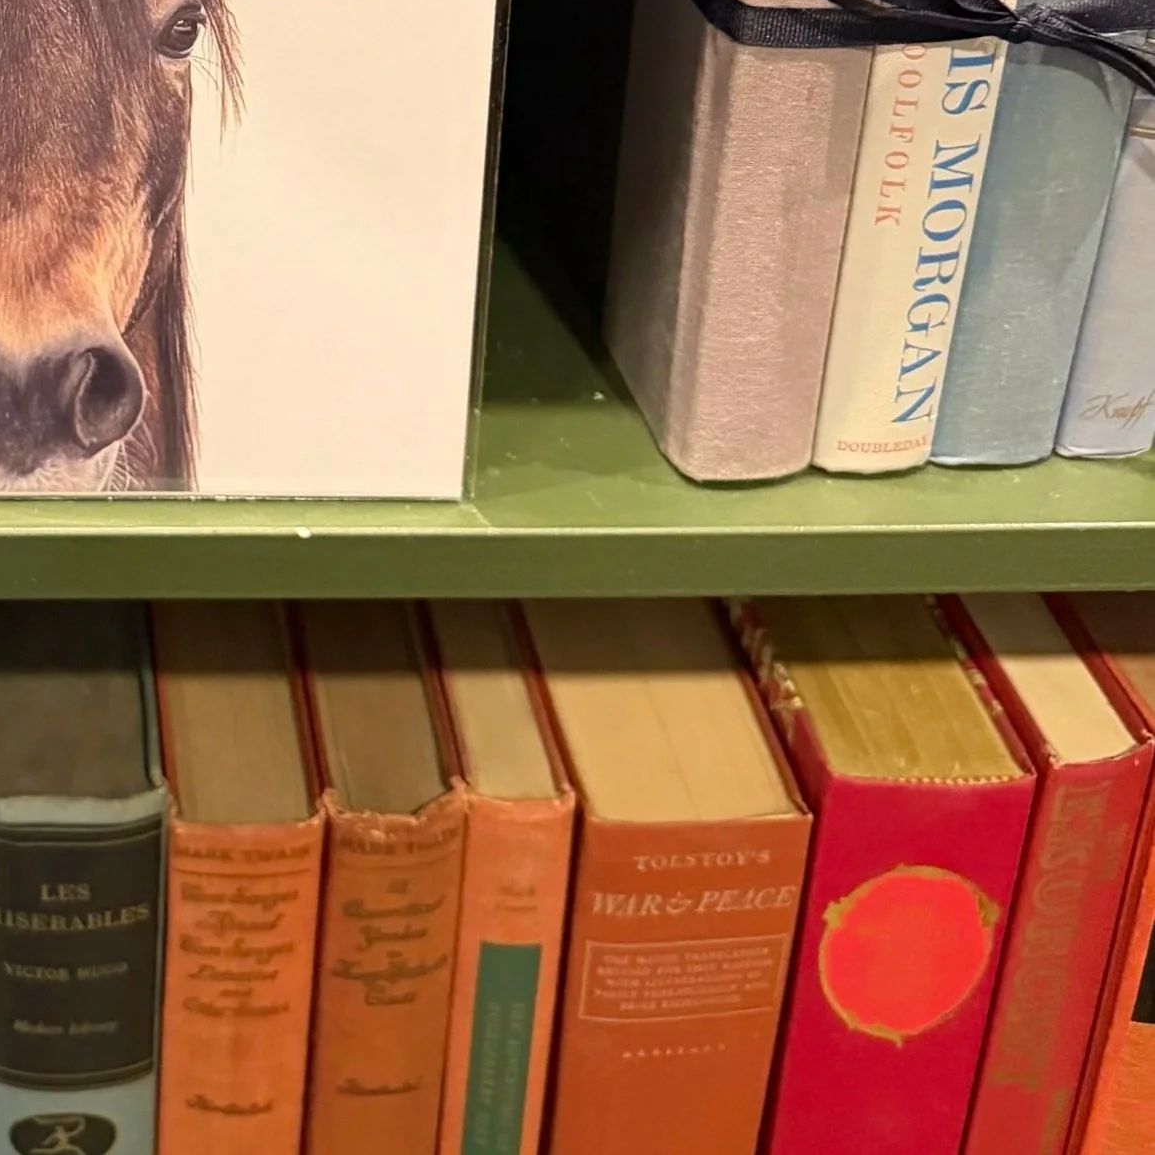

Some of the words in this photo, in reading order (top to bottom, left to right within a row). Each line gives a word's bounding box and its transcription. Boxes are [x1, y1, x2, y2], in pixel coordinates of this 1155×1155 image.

[941, 46, 998, 116] IS
[874, 43, 928, 226] OOLFOLK
[891, 134, 982, 425] MORGAN
[633, 849, 771, 873] TOLSTOY'S
[40, 883, 91, 902] LES
[591, 892, 662, 917] WAR
[665, 891, 694, 914] &
[695, 885, 798, 914] PEACE
[4, 961, 70, 981] VICTOR
